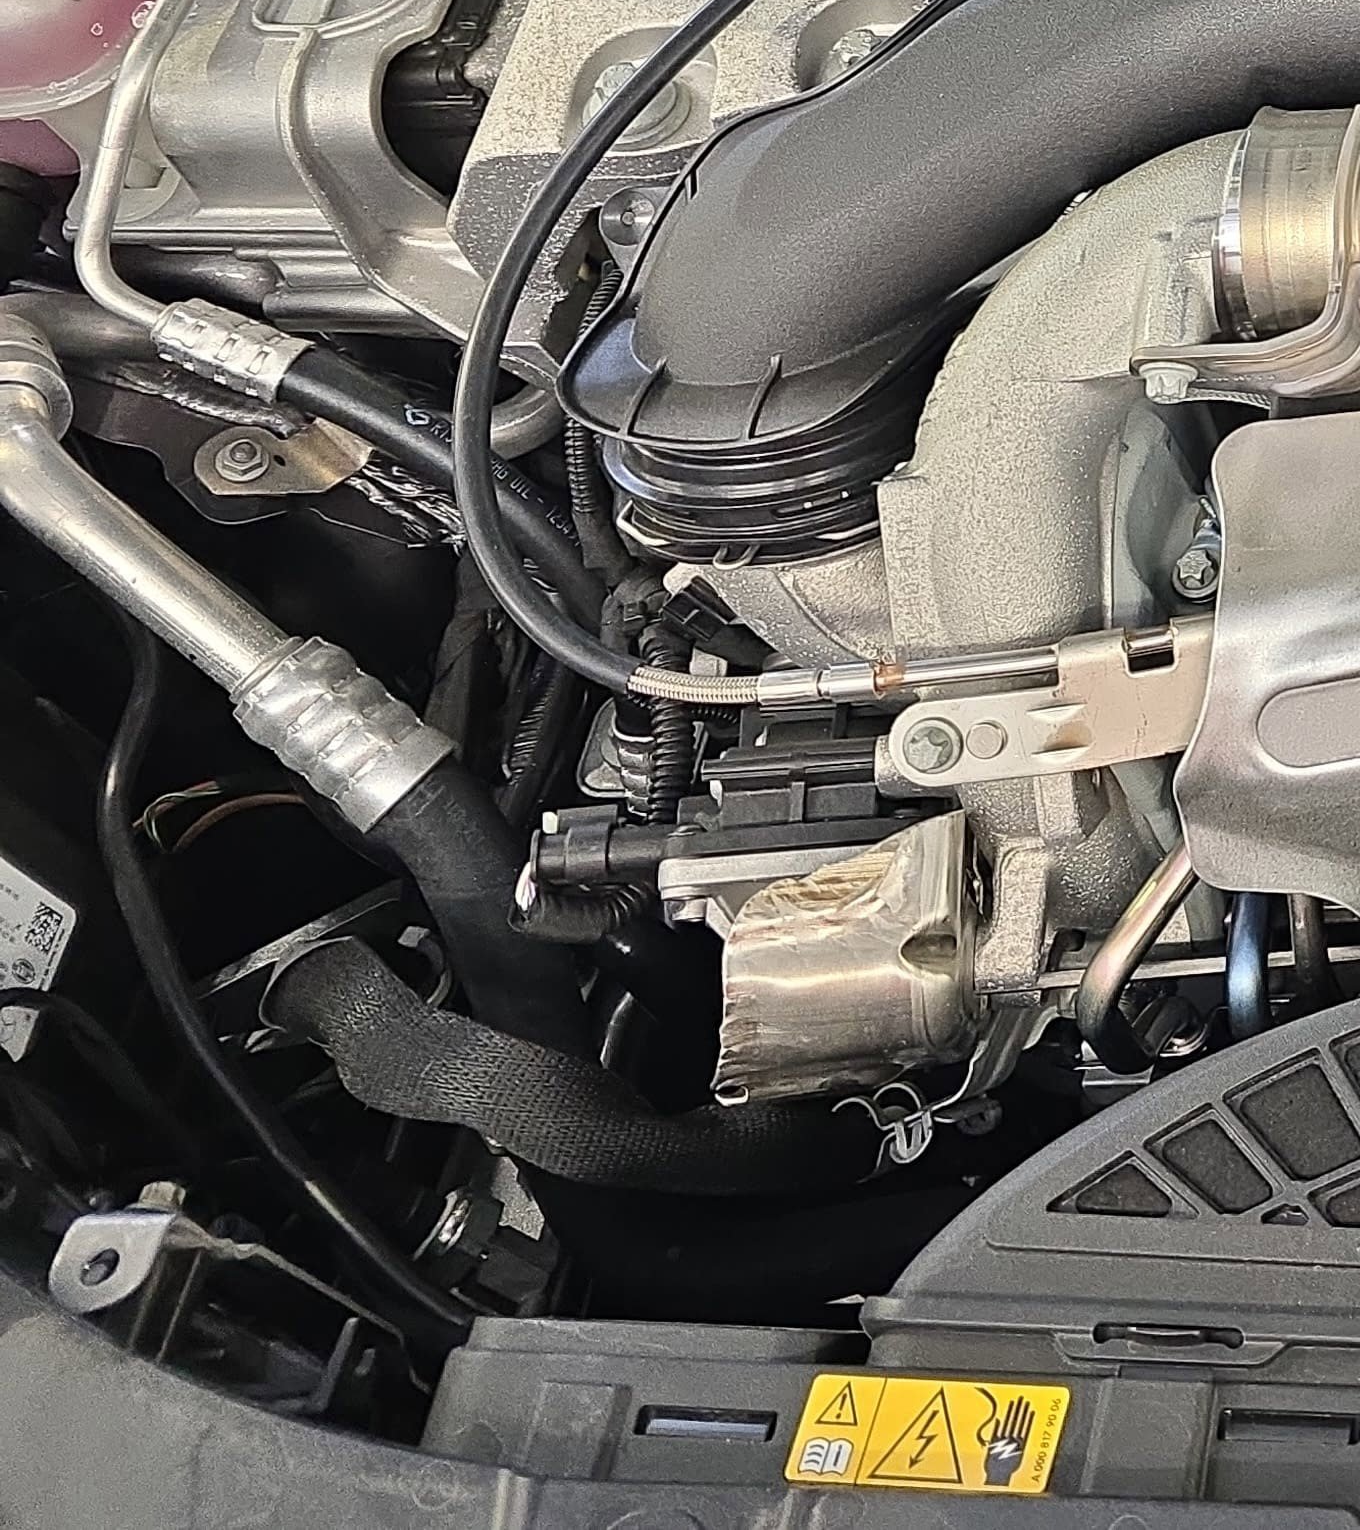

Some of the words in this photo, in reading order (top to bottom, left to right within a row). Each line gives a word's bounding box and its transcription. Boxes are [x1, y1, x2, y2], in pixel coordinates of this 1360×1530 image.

[1050, 1397, 1061, 1413] 06
[1045, 1413, 1057, 1428] 90
[1040, 1430, 1053, 1449] 817
[1034, 1451, 1047, 1472] 000
[1031, 1474, 1041, 1482] A
